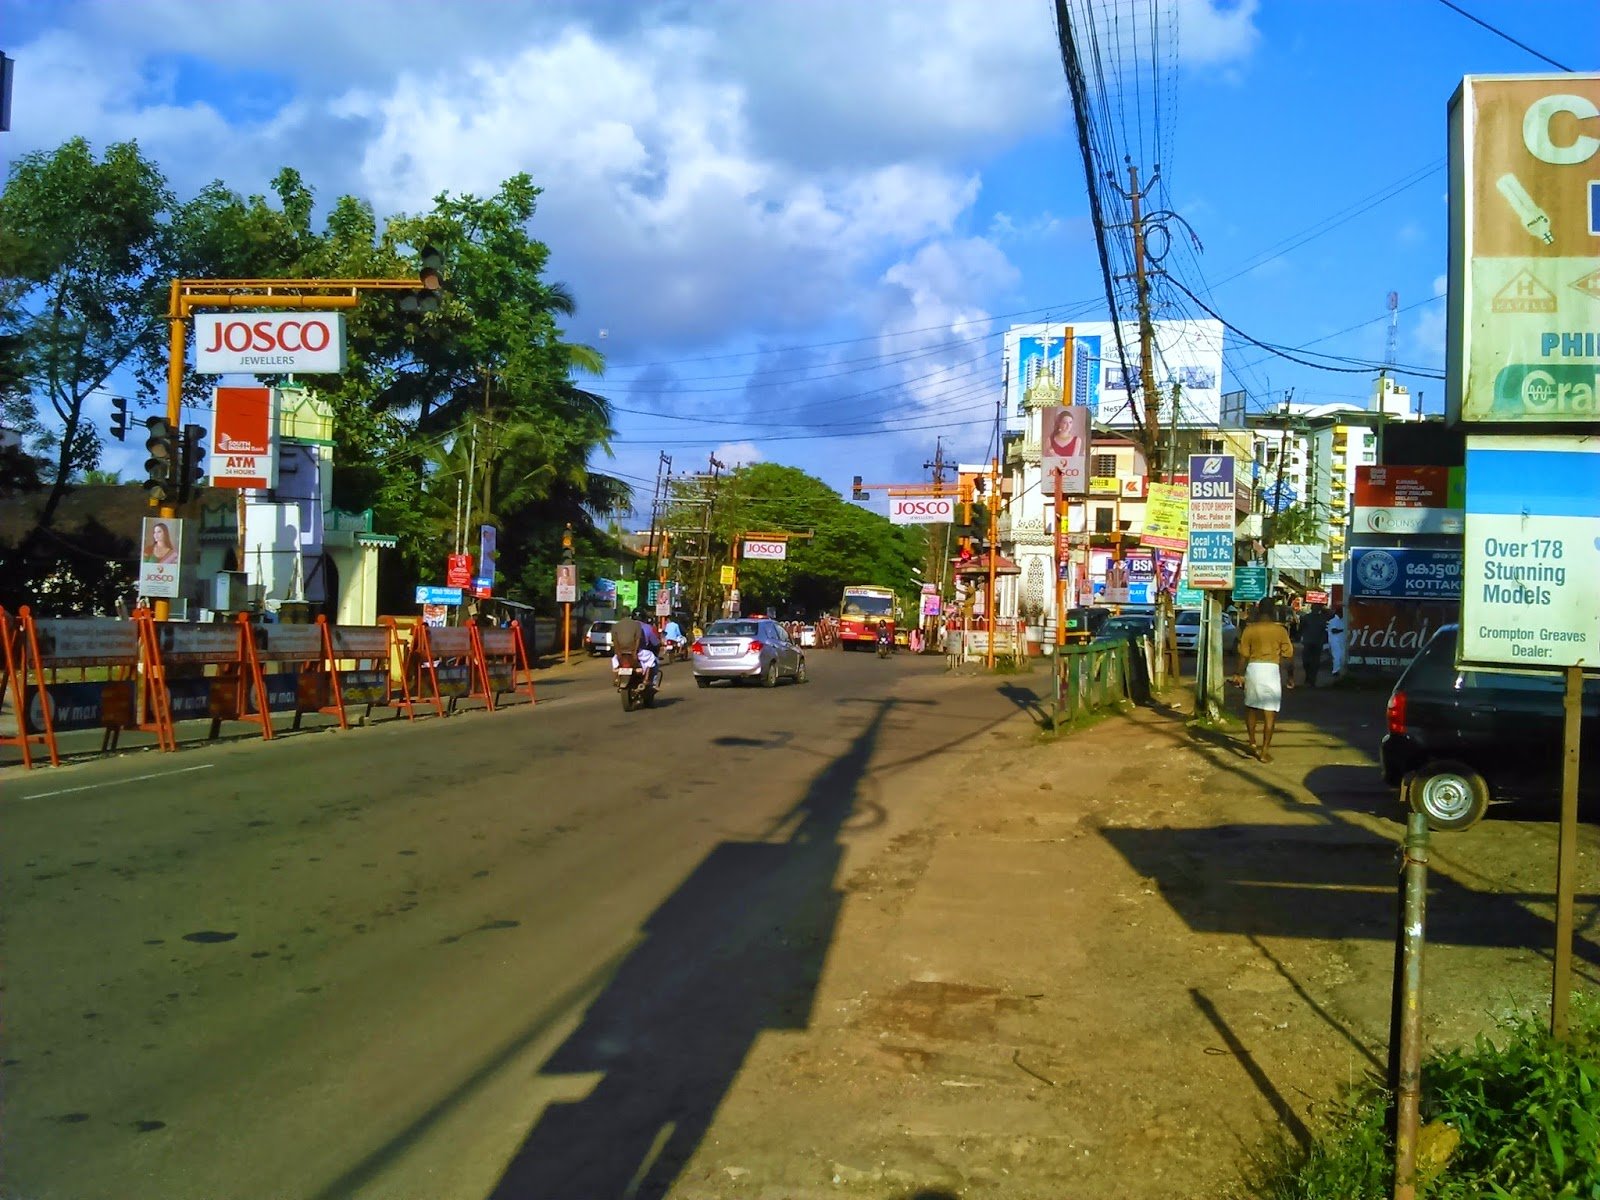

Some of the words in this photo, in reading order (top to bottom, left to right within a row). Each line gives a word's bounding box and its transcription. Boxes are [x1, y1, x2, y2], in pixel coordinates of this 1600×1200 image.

[206, 320, 330, 353] JOSCO
[1541, 332, 1600, 357] PHI
[239, 356, 295, 366] JEWELLERS
[226, 456, 256, 468] ATM
[1192, 481, 1234, 498] BSNL
[894, 501, 950, 515] JOSCO
[1201, 502, 1214, 511] STOP
[1190, 534, 1210, 546] Local
[1215, 534, 1220, 546] 1
[1221, 534, 1233, 546] Ps.
[746, 543, 784, 554] JOSCO
[1192, 547, 1208, 559] STD
[1212, 547, 1218, 559] 2
[1219, 547, 1230, 559] Ps.
[1484, 538, 1528, 558] Over
[1531, 539, 1564, 559] 178
[145, 574, 174, 582] JOSCO
[1483, 560, 1566, 586] Stunning
[1482, 584, 1551, 606] Models
[1479, 625, 1534, 643] Crompton
[1539, 628, 1587, 643] Greaves
[1512, 644, 1553, 659] Dealer:
